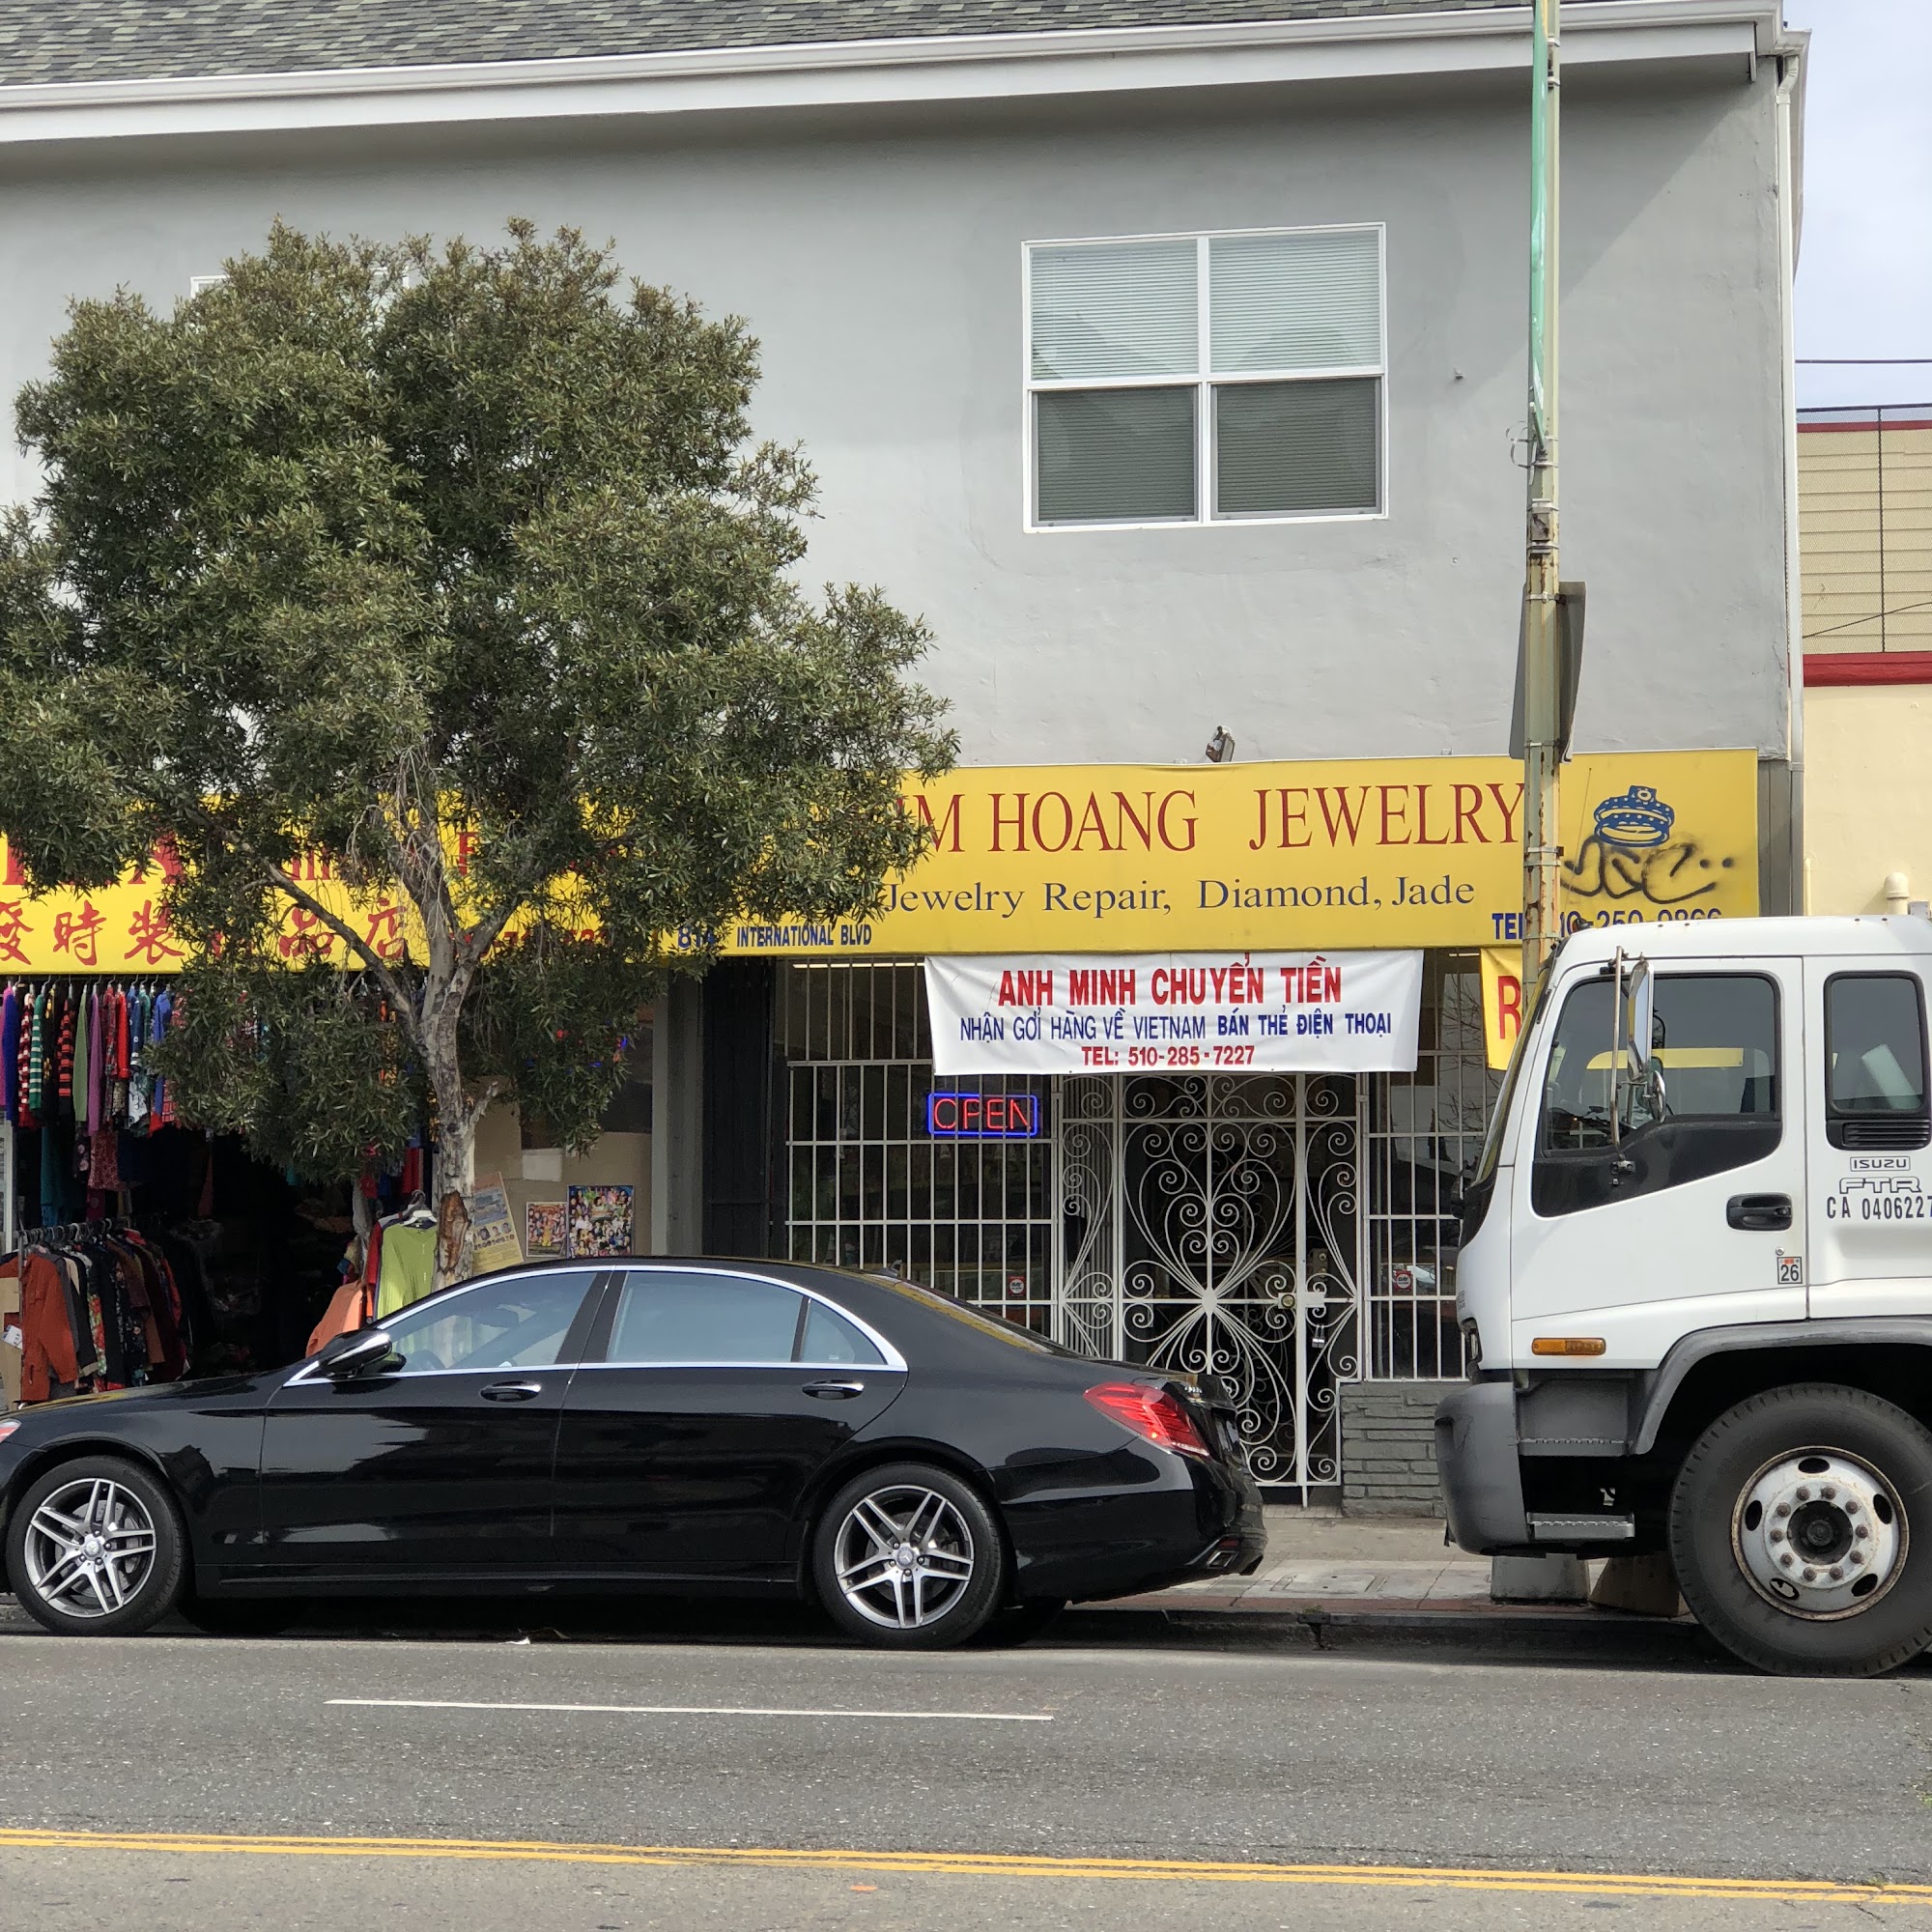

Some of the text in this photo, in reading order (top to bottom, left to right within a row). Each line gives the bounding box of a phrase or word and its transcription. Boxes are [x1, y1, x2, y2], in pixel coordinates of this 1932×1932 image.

[987, 789, 1199, 853] HOANG
[1248, 782, 1524, 851] JEWELRY
[884, 875, 1475, 919] Jewelry Repair, Diamond, Jade
[736, 924, 835, 948] INTERNATIONAL
[840, 923, 872, 947] BLVD
[998, 952, 1342, 1007] ANH MINH CHUYỂN TIỀN
[960, 1011, 1005, 1043] NHẬN
[1051, 1009, 1096, 1040] HÀNG
[1103, 1008, 1125, 1040] VỀ
[1133, 1015, 1207, 1039] VIETNAM
[1217, 1007, 1249, 1037] BÁN
[1258, 1005, 1289, 1037] THẺ
[1296, 1008, 1334, 1039] ĐIỆN
[1345, 1012, 1392, 1038] THOẠI
[1081, 1046, 1120, 1066] TEL:
[933, 1097, 1032, 1130] OPEN
[1853, 1158, 1907, 1169] ISUZU
[1838, 1176, 1922, 1195] FTR
[1827, 1196, 1852, 1219] CA
[1780, 1264, 1800, 1282] 26
